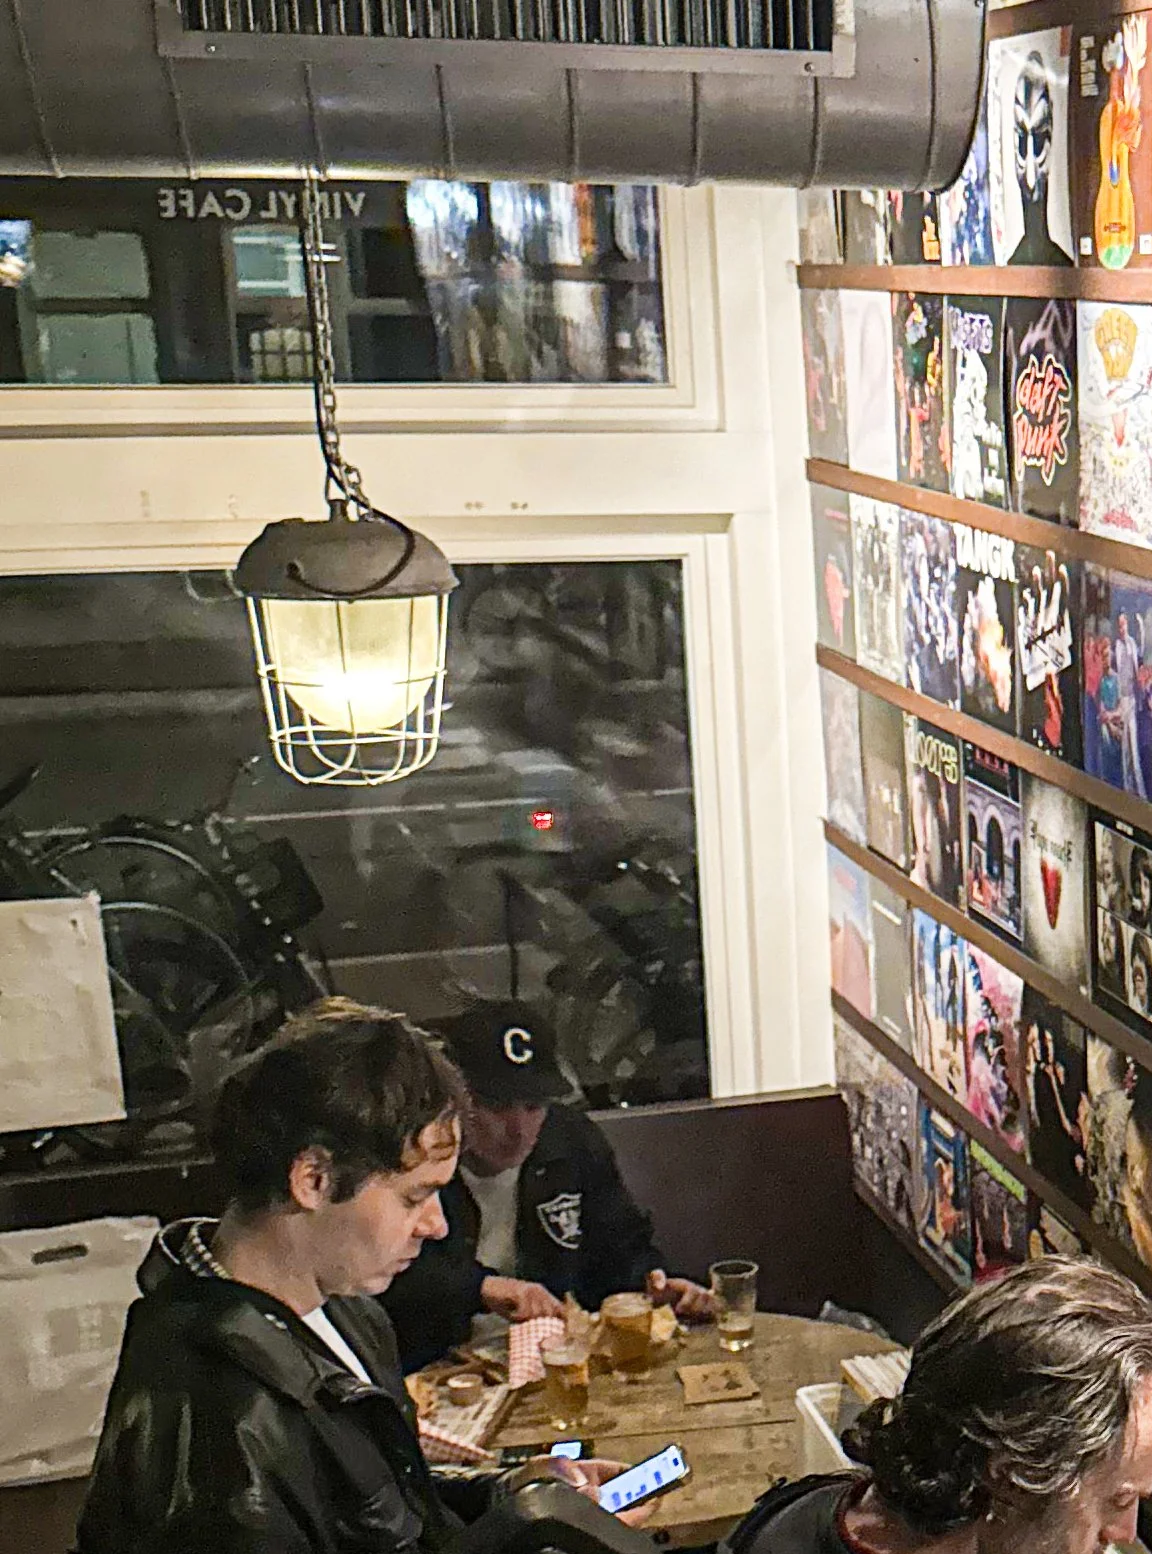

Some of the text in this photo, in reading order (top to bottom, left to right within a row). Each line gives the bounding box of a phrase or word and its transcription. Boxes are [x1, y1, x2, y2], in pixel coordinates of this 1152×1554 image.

[1016, 362, 1069, 424] daft
[1013, 411, 1067, 482] punk
[503, 1027, 534, 1064] C
